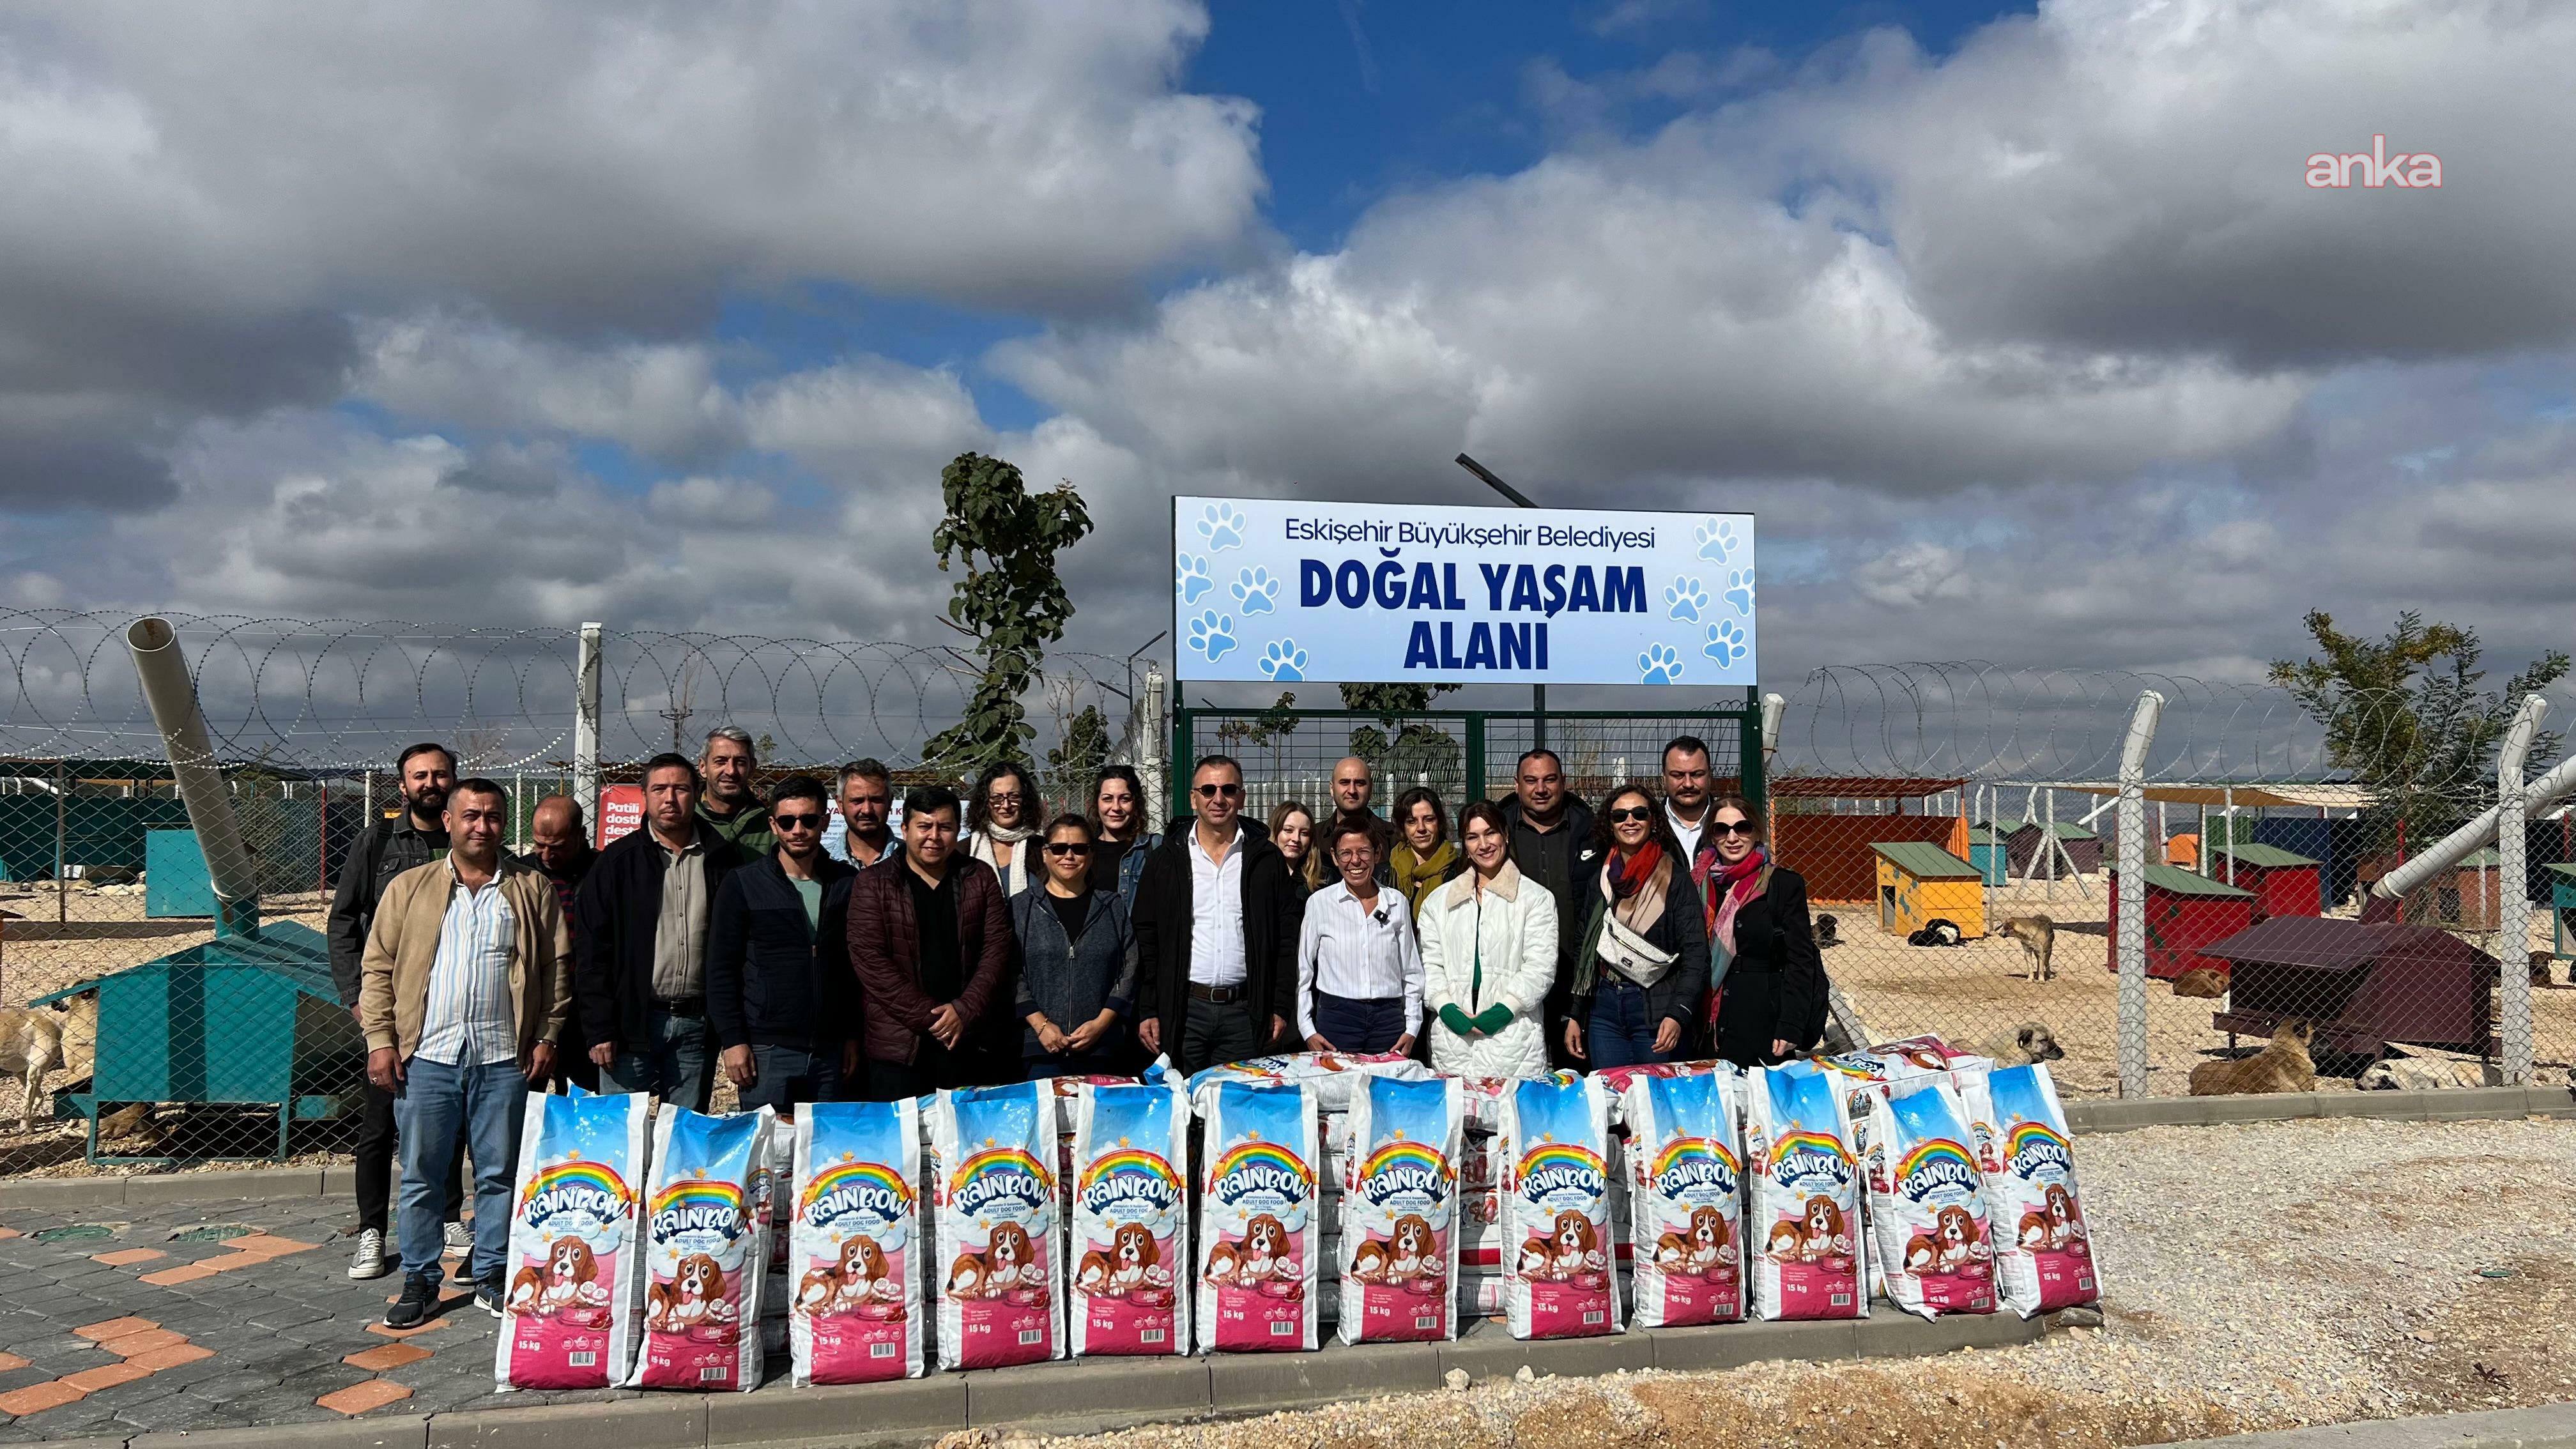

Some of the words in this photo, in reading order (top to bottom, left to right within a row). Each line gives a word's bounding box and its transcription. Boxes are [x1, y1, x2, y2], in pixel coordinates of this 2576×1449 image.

[1285, 518, 1393, 543] Eskişehir
[1398, 522, 1532, 549] Büyükşehir
[1538, 526, 1655, 551] Belediyesi
[1300, 548, 1466, 611] DOĞAL
[1480, 563, 1647, 619] YAŞAM
[1404, 620, 1548, 670] ALANI
[607, 802, 640, 813] Patili
[1797, 1284, 1807, 1294] kg
[1681, 1295, 1691, 1304] kg
[1380, 1307, 1390, 1316] kg
[1548, 1303, 1558, 1314] kg
[1223, 1310, 1232, 1318] 15
[1234, 1310, 1244, 1320] kg
[969, 1324, 977, 1333] 15
[980, 1324, 990, 1333] kg
[1103, 1319, 1113, 1329] kg
[519, 1340, 527, 1349] 15
[529, 1340, 540, 1351] kg
[830, 1337, 841, 1346] kg
[650, 1355, 658, 1364] 15
[659, 1356, 670, 1367] kg
